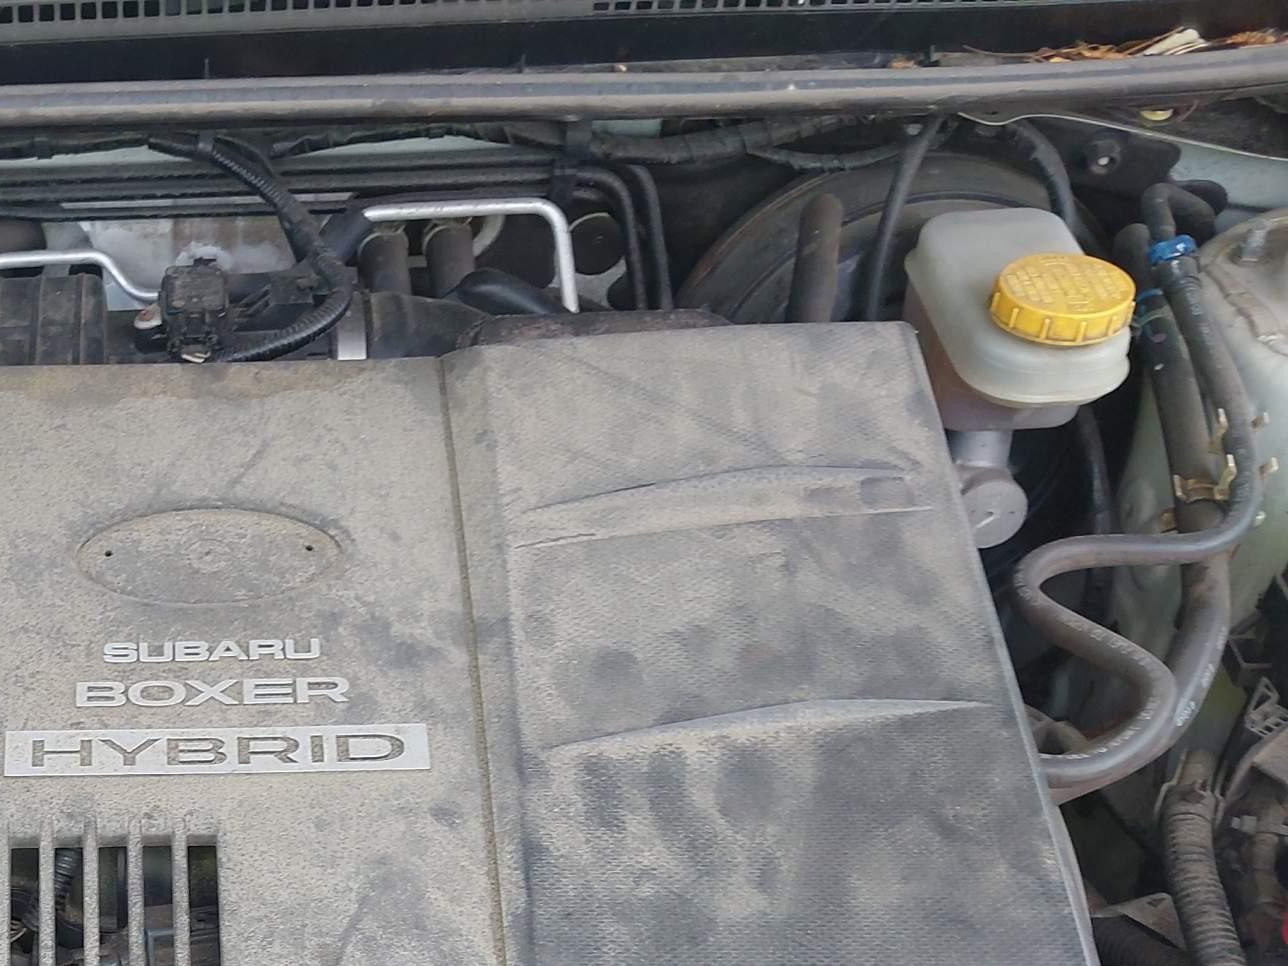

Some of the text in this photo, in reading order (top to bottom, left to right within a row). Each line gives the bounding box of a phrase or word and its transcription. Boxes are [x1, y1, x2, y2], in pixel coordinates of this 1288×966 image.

[103, 638, 322, 663] SUBARU
[75, 676, 351, 707] BOXER
[31, 733, 405, 767] HYBRID
